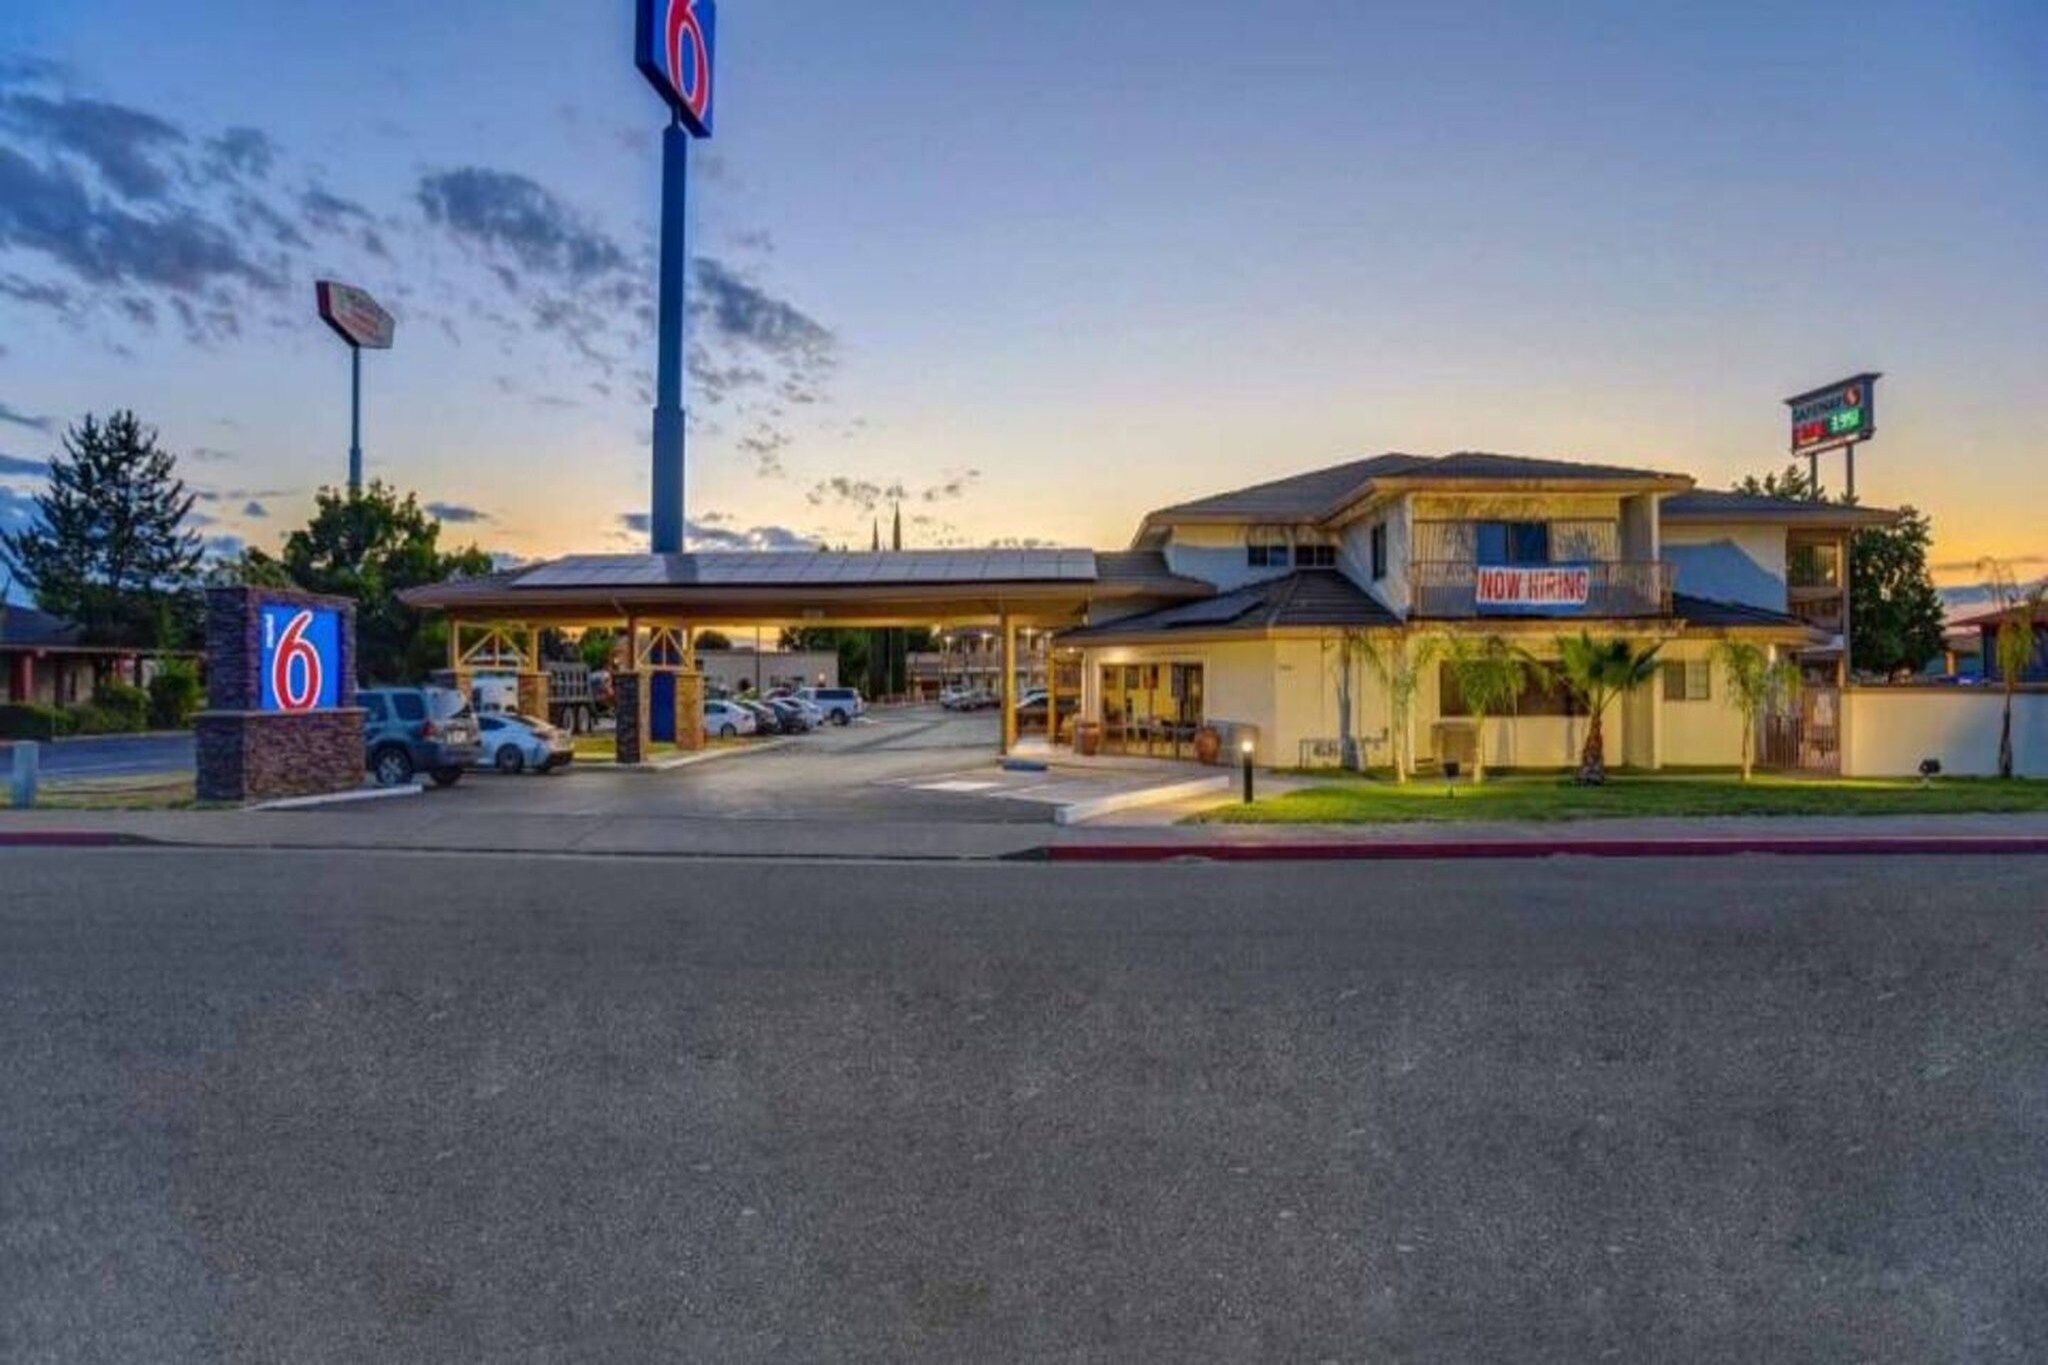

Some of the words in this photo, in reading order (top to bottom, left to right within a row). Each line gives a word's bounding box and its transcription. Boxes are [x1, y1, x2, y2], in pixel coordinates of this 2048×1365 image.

[665, 0, 709, 121] 6
[1479, 570, 1520, 599] NOW
[1528, 570, 1586, 599] HIRING
[272, 609, 322, 712] 6
